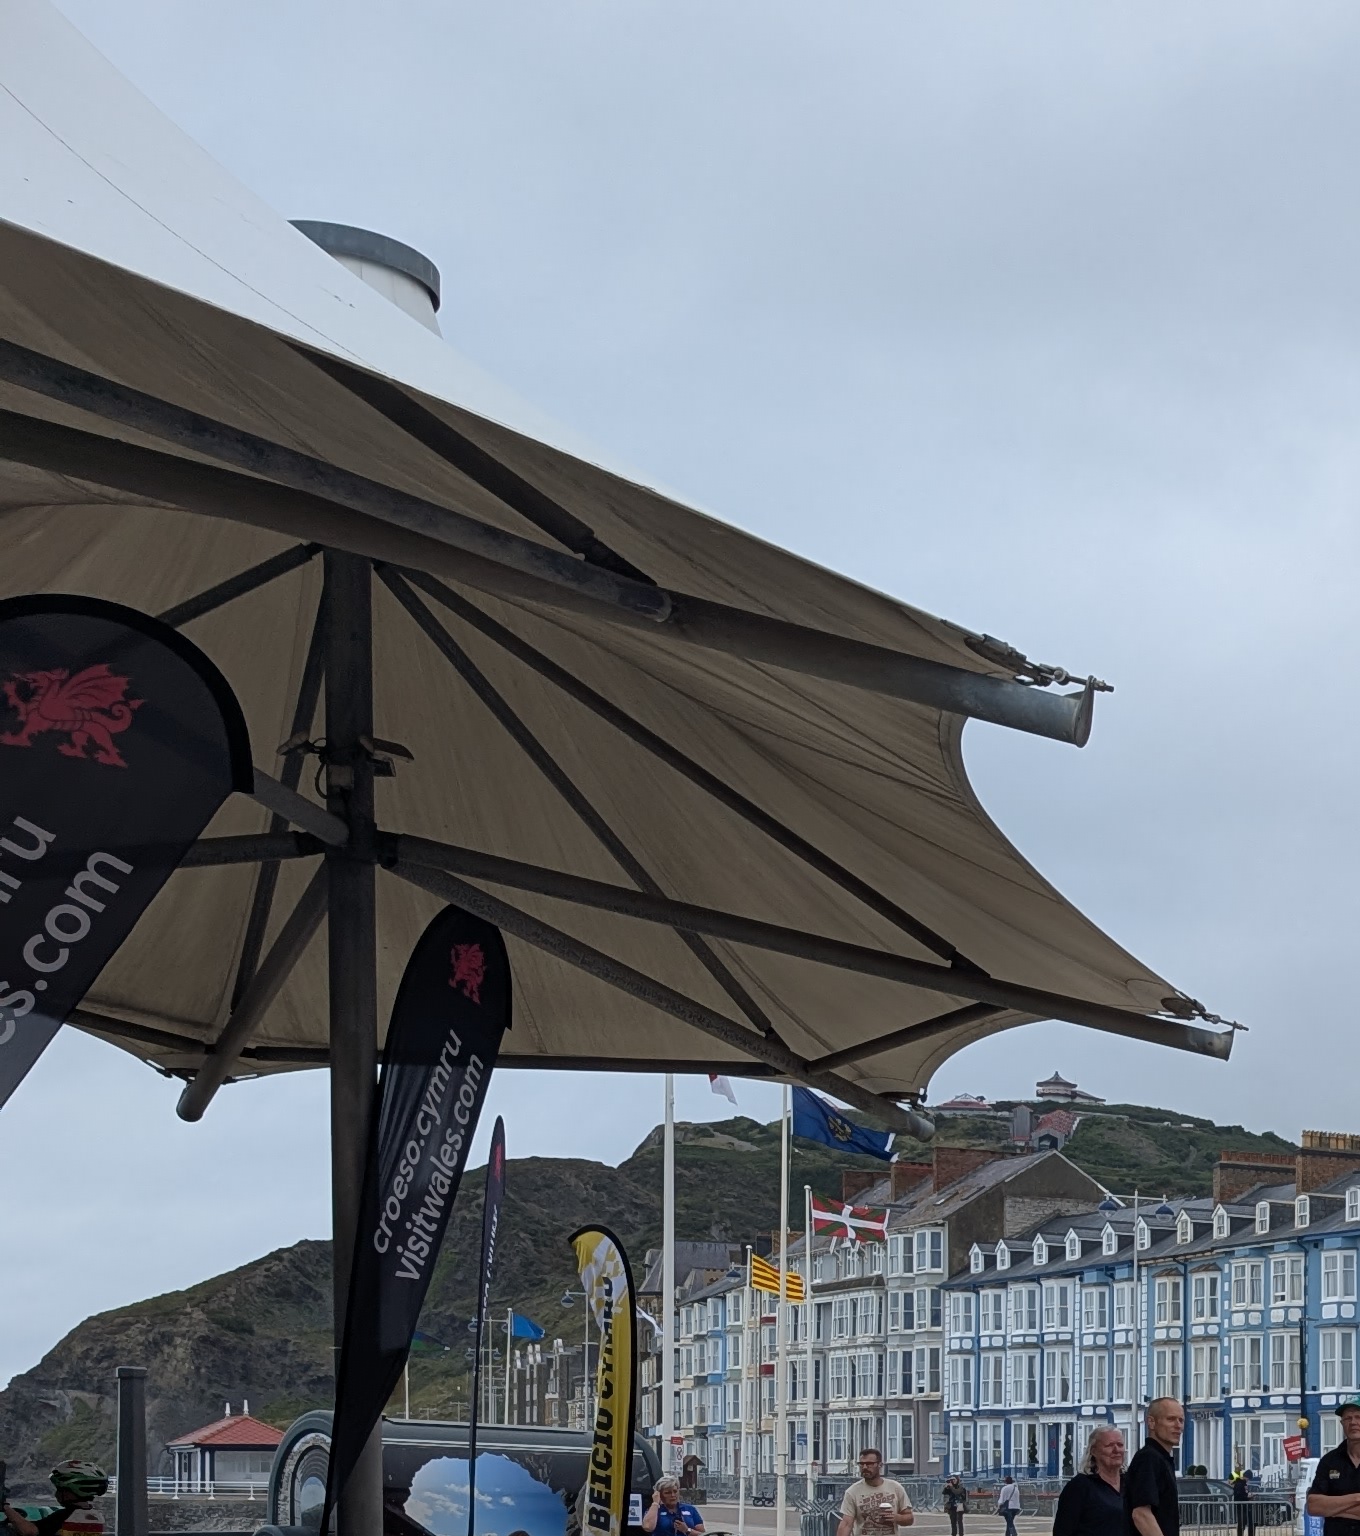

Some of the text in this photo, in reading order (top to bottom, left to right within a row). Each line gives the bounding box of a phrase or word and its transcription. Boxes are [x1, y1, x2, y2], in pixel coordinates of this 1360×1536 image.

[373, 1029, 462, 1254] croeso.cymru
[395, 1054, 484, 1280] visitwales.com
[588, 1405, 614, 1533] BEICIO
